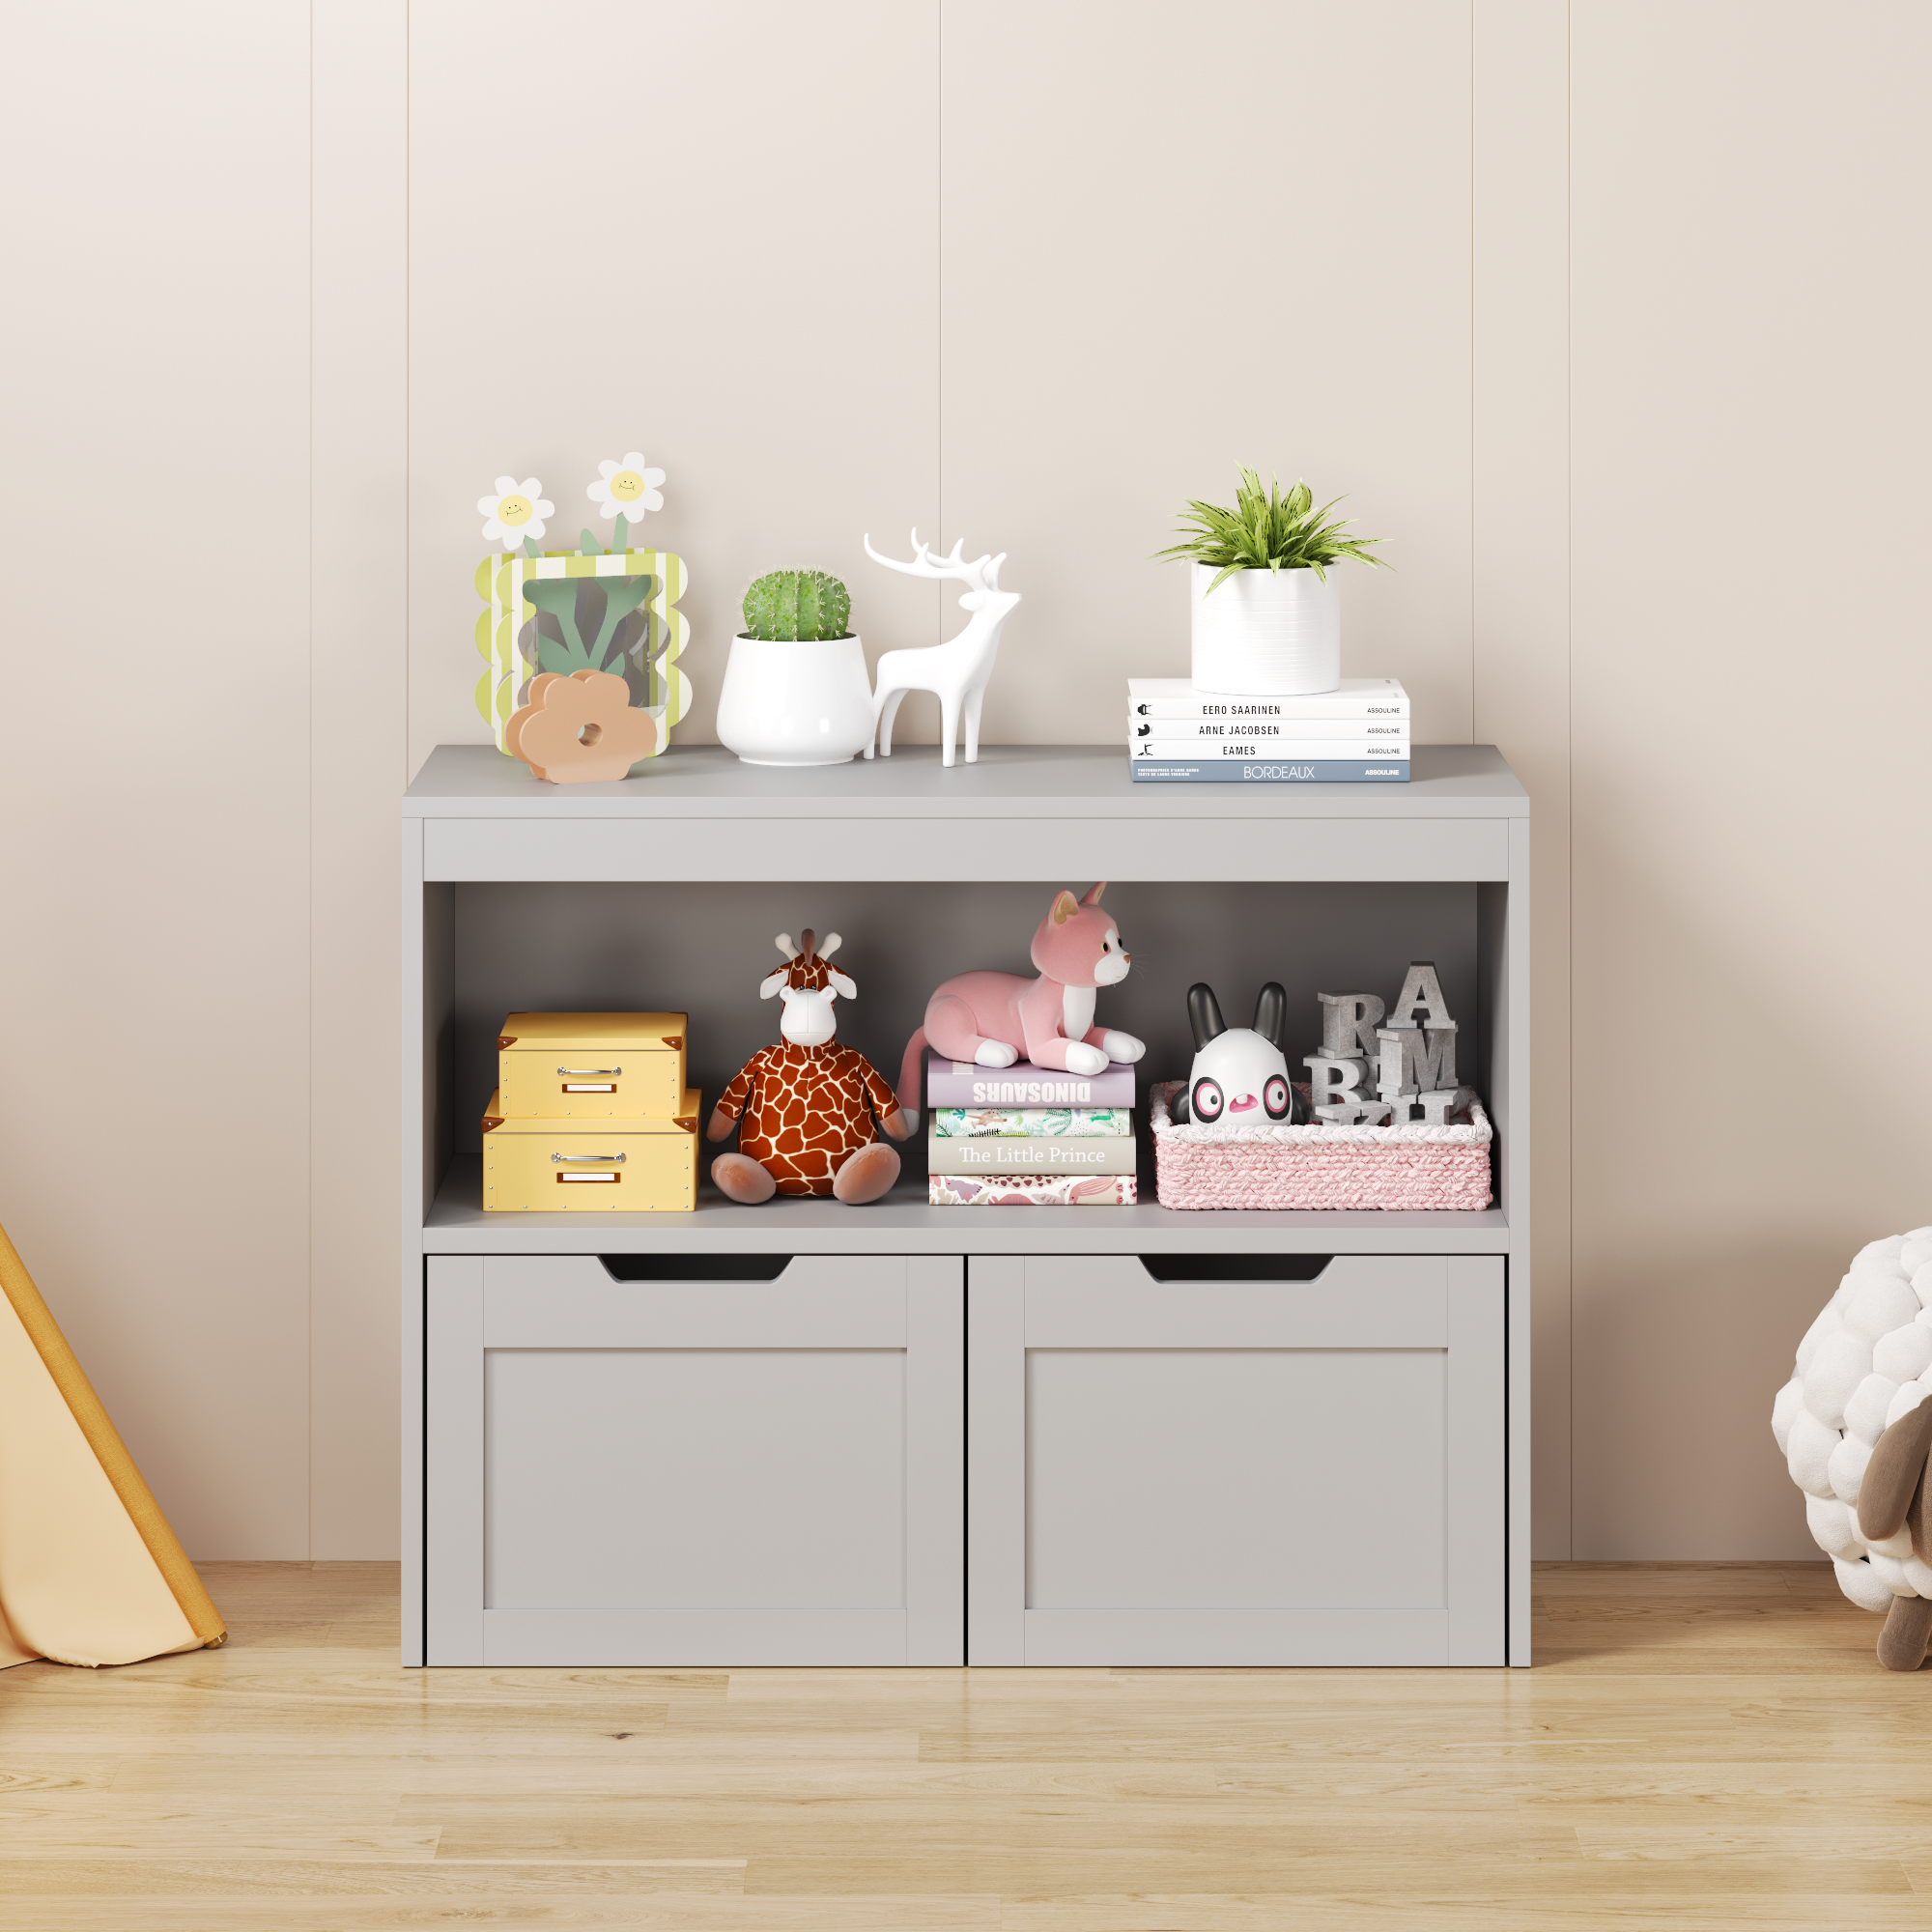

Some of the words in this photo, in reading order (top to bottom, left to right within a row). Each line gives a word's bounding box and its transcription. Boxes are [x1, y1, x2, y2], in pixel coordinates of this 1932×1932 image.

[1202, 705, 1227, 715] EERO
[1231, 705, 1281, 715] SAARINEN
[1199, 725, 1225, 735] ARNE
[1228, 725, 1280, 735] JACOBSEN
[1222, 746, 1257, 755] EAMES
[1243, 765, 1316, 780] BORDEAUX
[973, 1082, 1091, 1103] DINOSAURS
[959, 1147, 991, 1163] The
[996, 1146, 1044, 1163] Little
[1049, 1147, 1106, 1163] Prince
